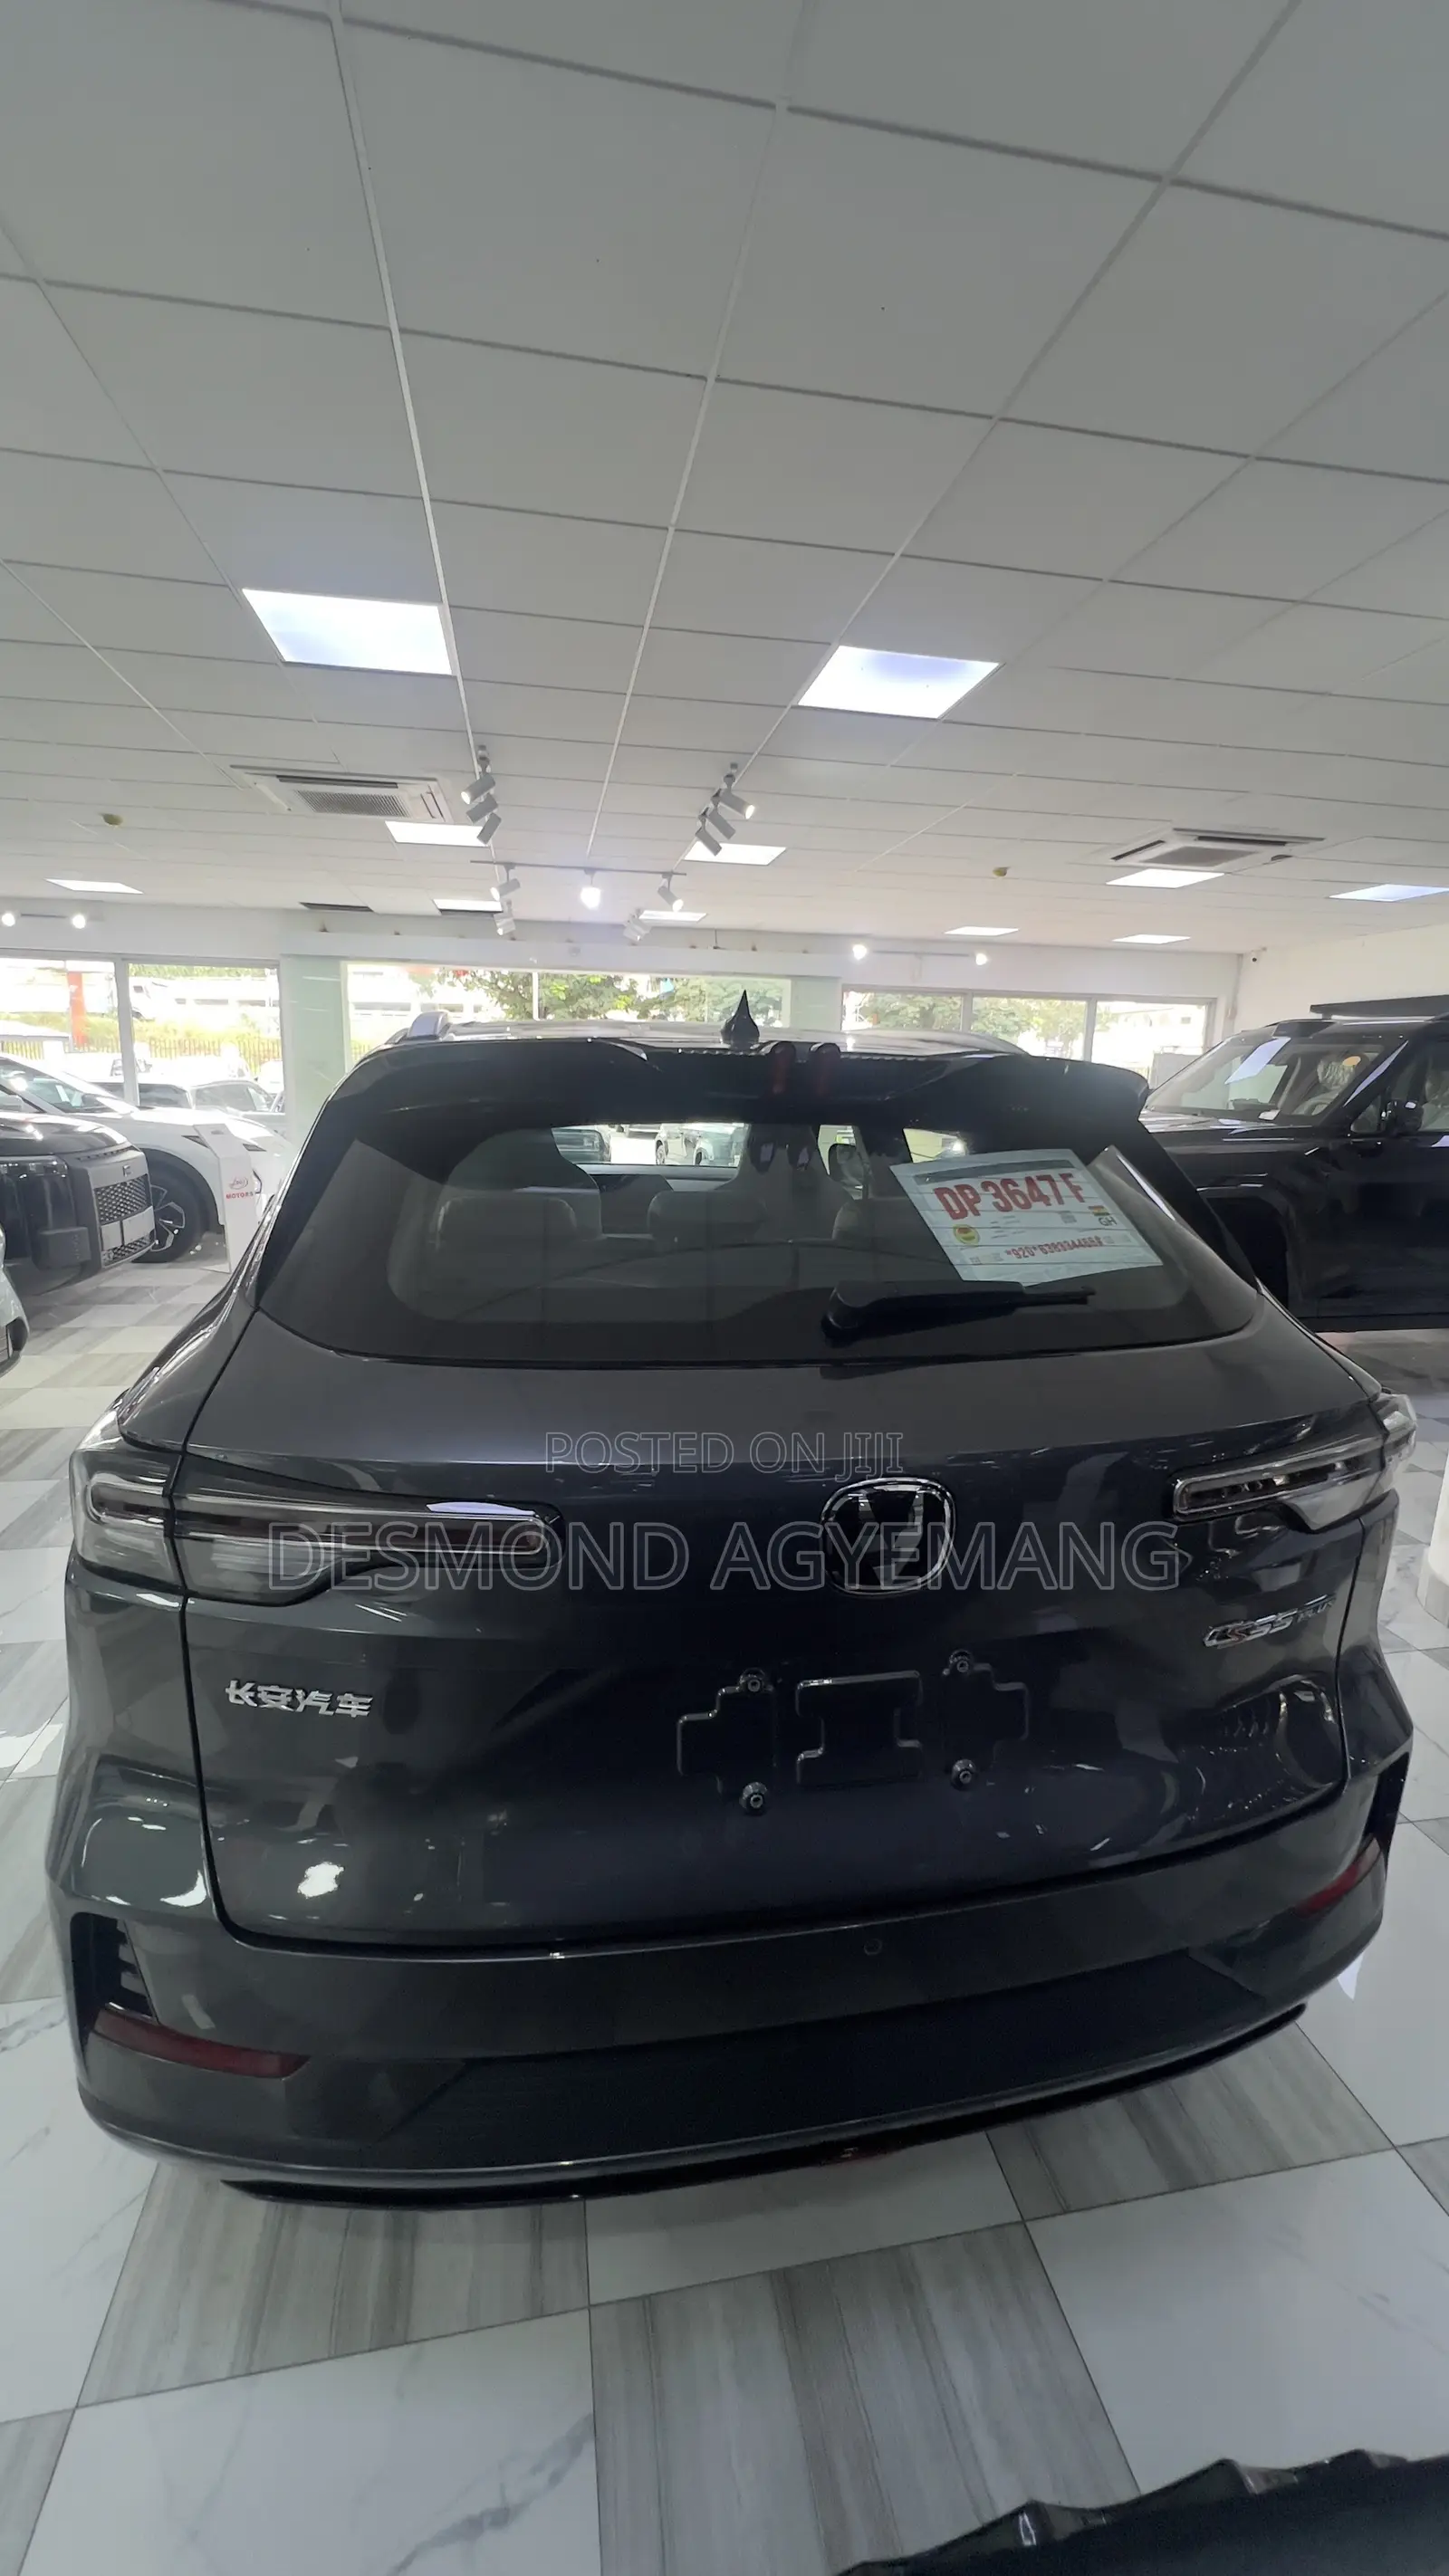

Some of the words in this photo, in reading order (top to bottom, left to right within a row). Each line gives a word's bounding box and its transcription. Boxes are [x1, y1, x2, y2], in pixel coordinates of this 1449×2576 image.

[933, 1183, 982, 1221] DP
[980, 1173, 1065, 1213] 3647
[1059, 1173, 1086, 1203] F
[225, 1680, 374, 1719] 长安汽车
